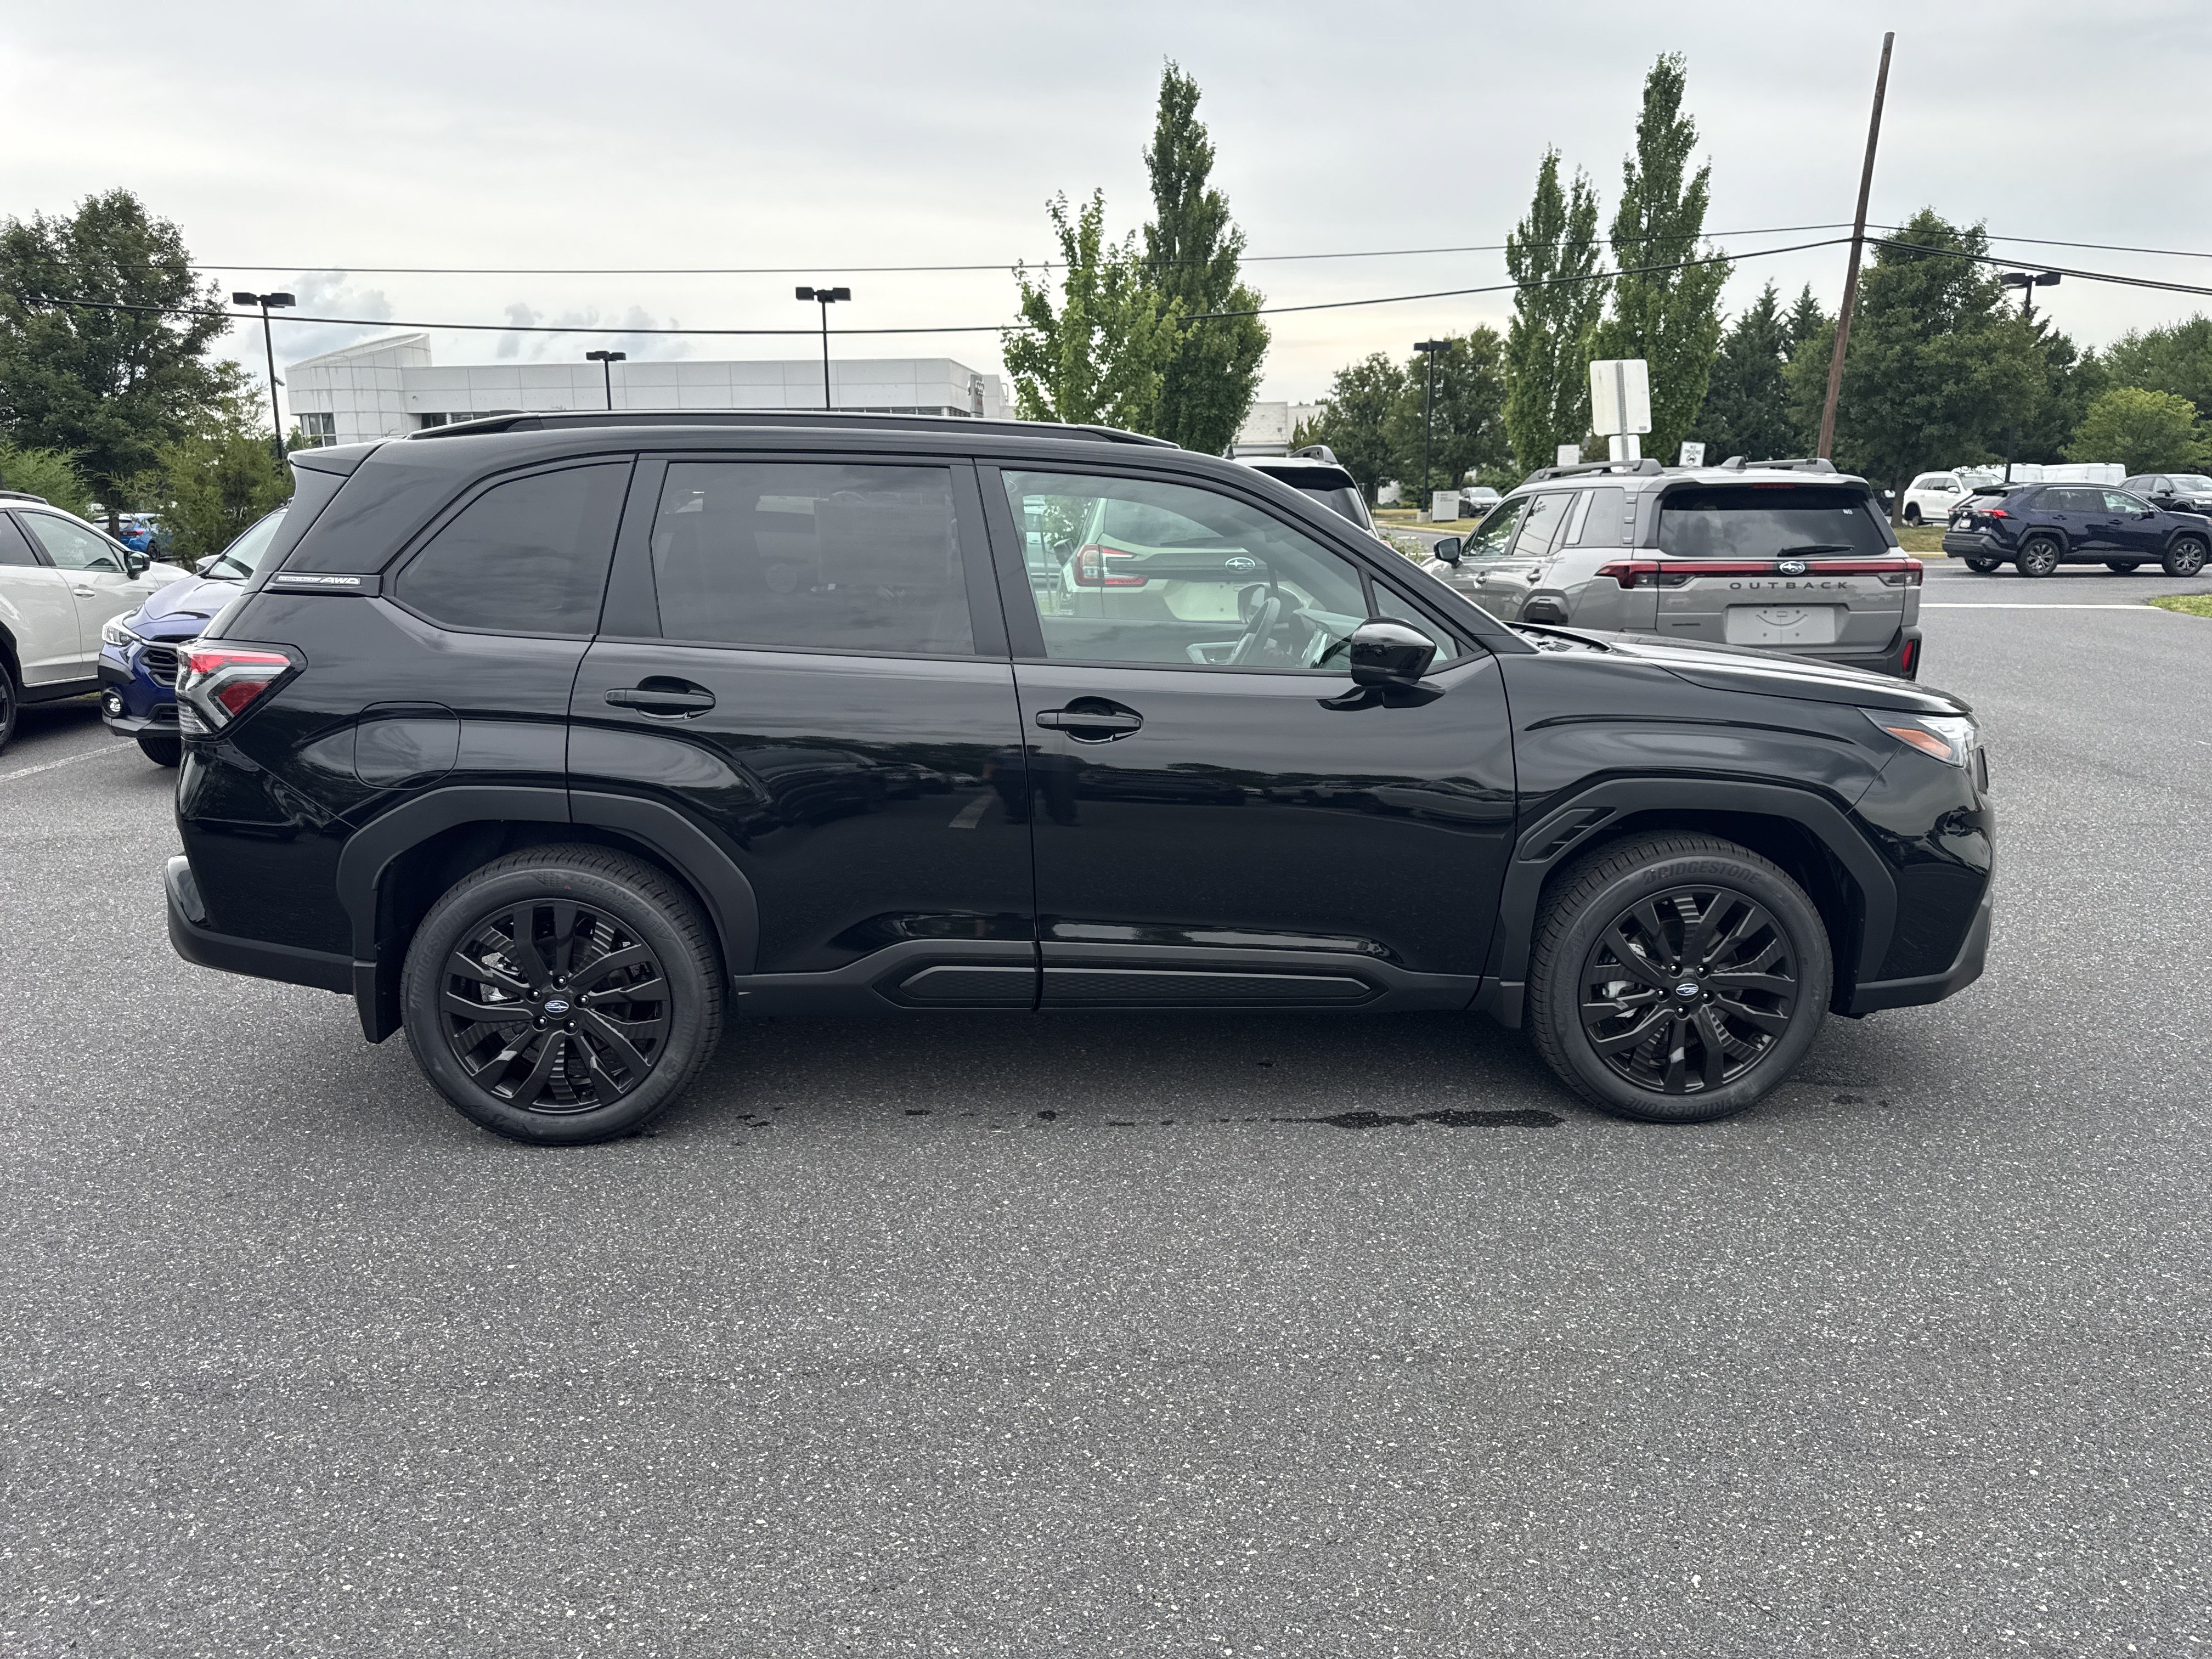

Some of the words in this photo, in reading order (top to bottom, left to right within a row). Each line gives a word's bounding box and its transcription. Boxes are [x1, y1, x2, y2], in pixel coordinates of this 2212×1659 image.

[1730, 582, 1848, 590] OUTBACK
[1643, 860, 1762, 885] BRIDGESTONE
[567, 874, 652, 917] TURANZA
[409, 901, 469, 1011] BRIDGESTONE
[1622, 1094, 1740, 1120] BRIDGESTONE
